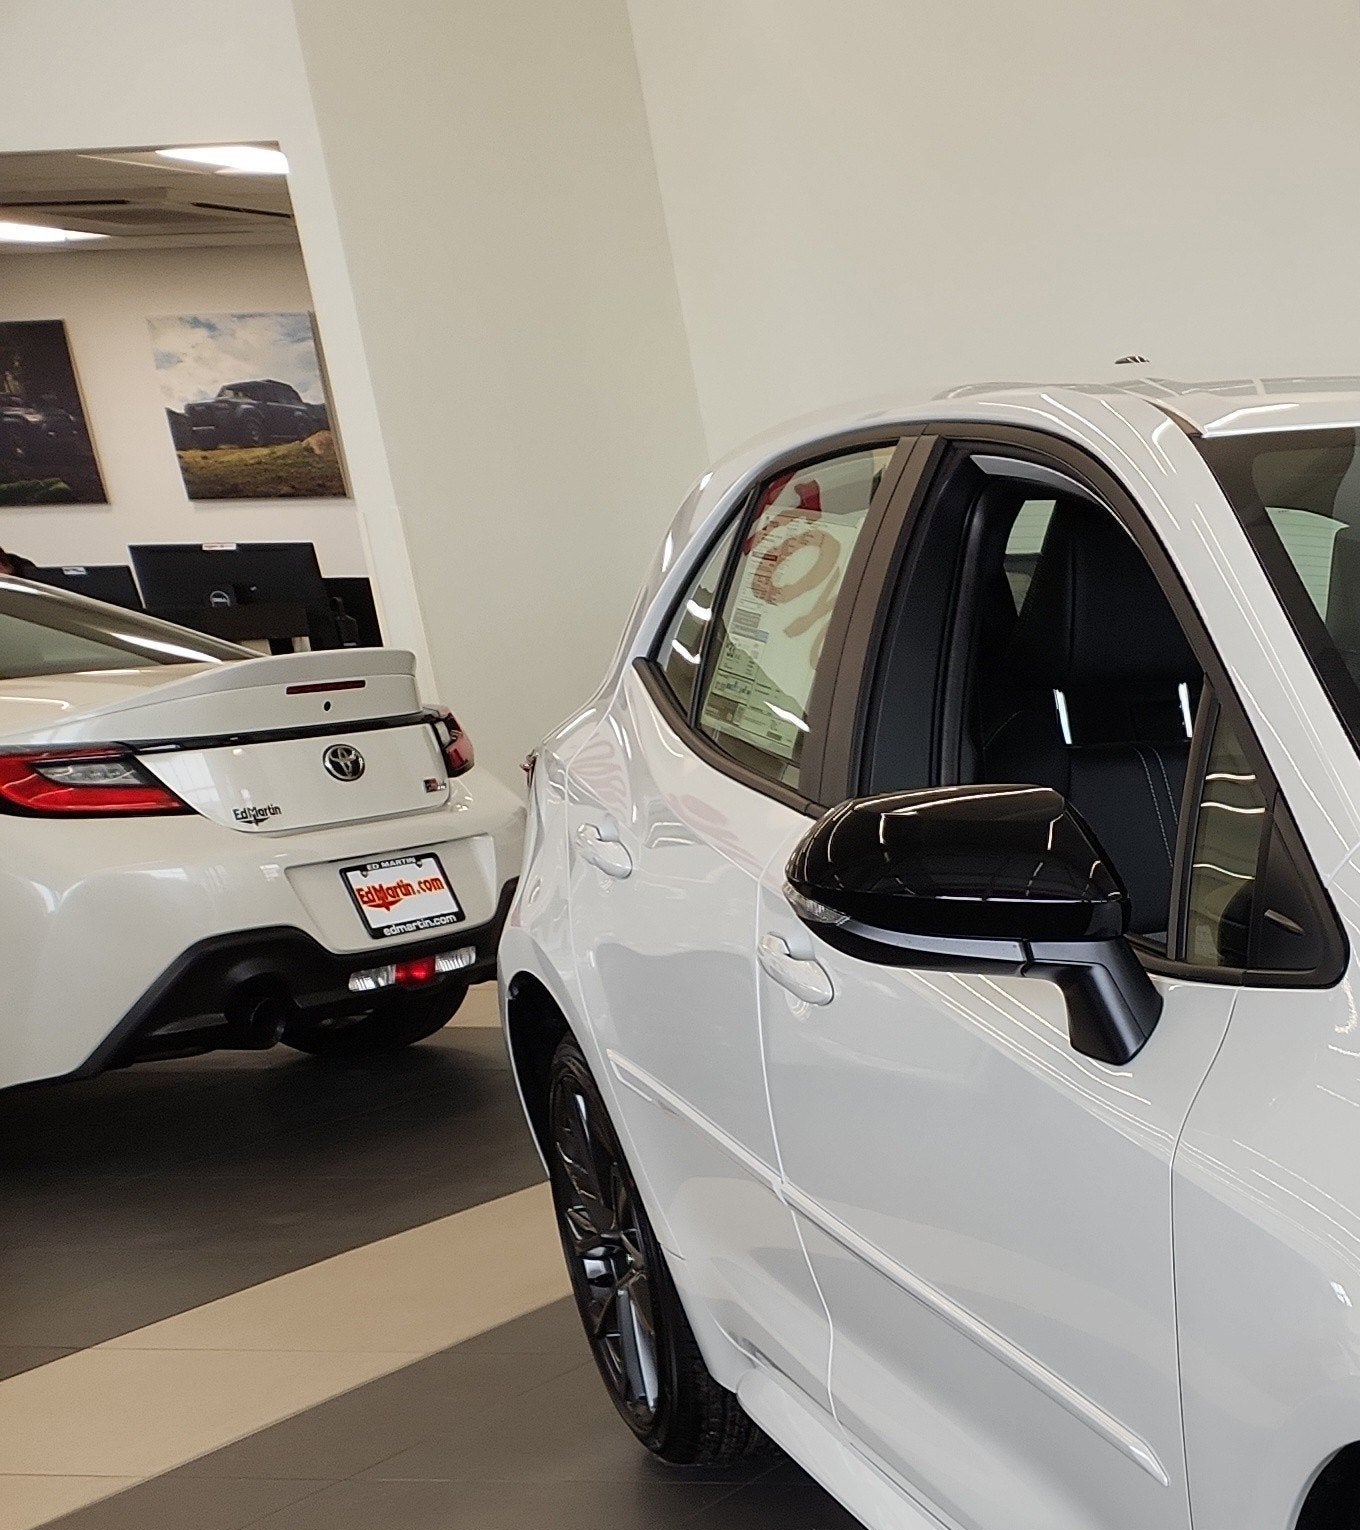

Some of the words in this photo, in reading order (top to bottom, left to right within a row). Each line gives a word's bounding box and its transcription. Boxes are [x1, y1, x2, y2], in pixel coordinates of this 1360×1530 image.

[366, 863, 380, 871] ED
[381, 857, 416, 869] MARTIN
[383, 913, 457, 937] edmartin.com
